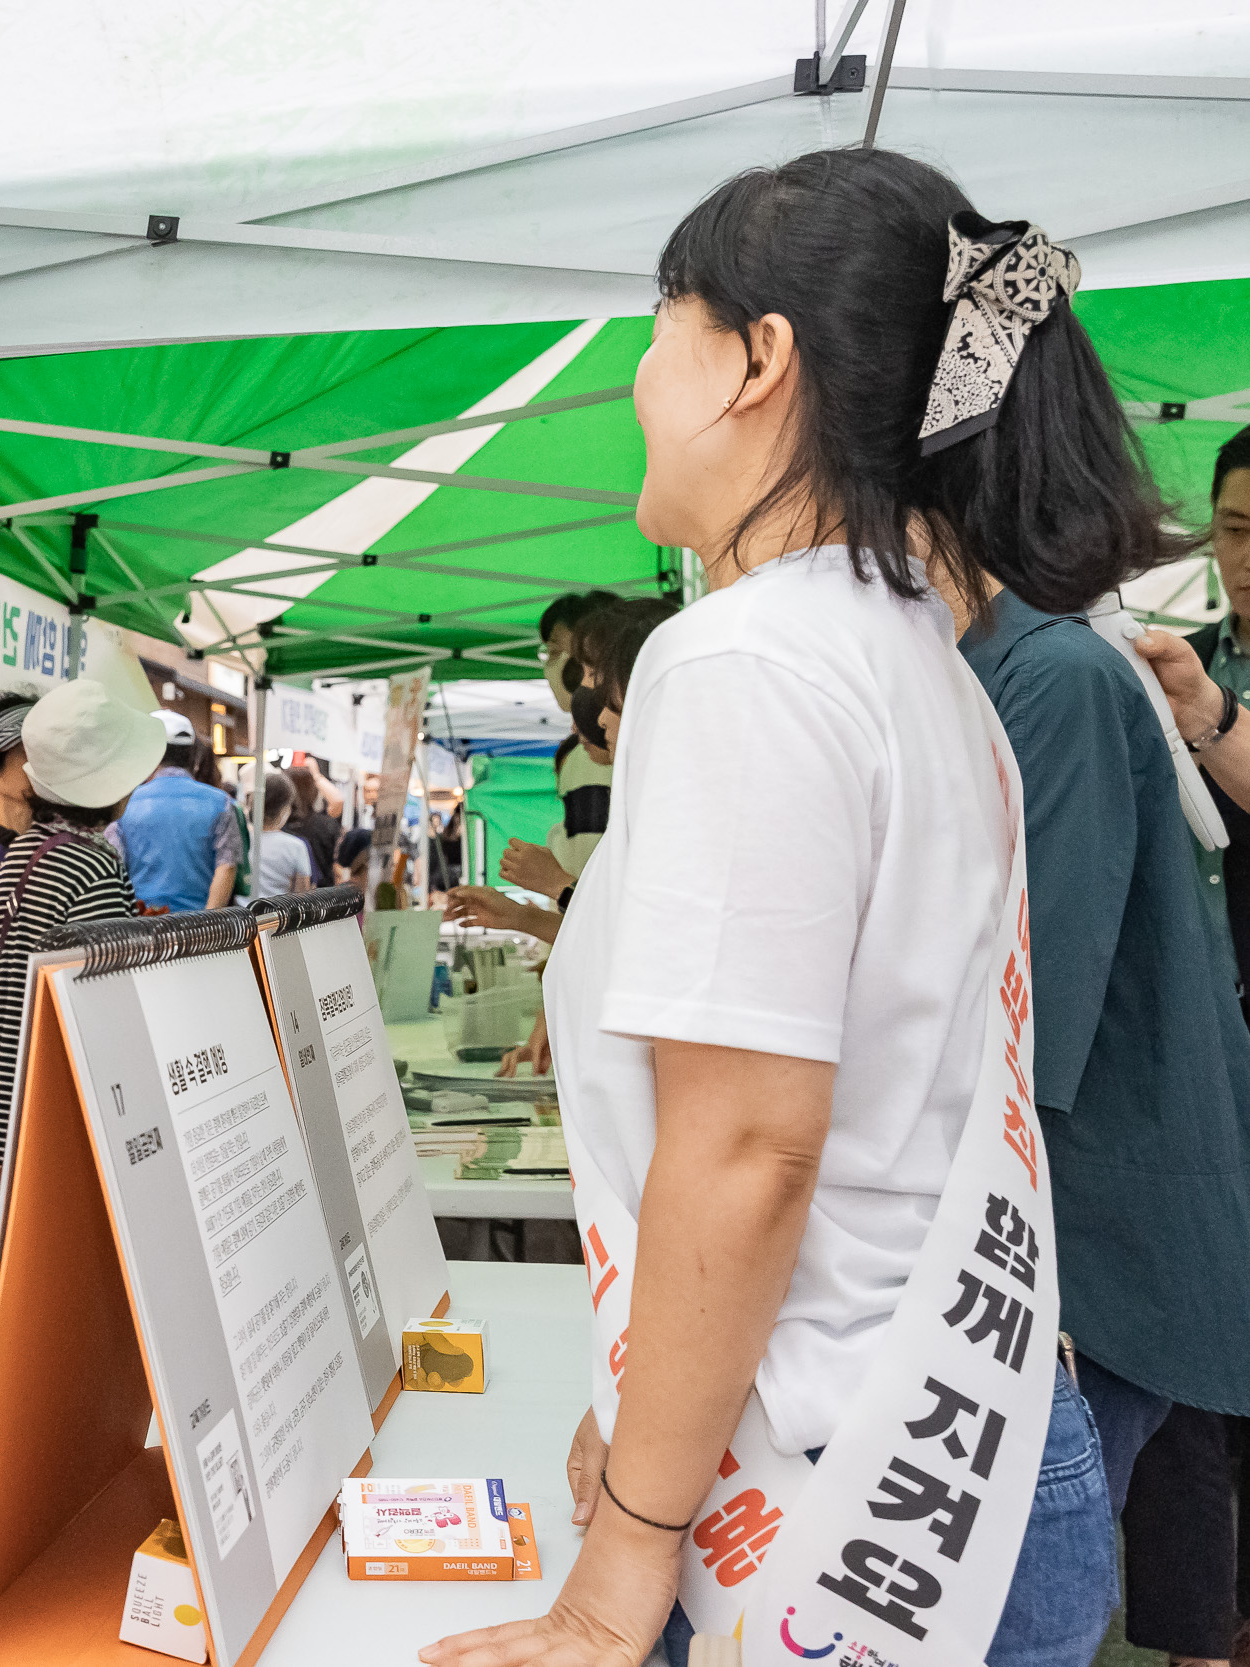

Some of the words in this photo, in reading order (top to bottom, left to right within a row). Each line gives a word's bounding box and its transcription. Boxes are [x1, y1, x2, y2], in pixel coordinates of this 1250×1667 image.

[290, 1011, 299, 1034] 14
[166, 1060, 187, 1094] 생활
[184, 1056, 197, 1086] 속
[193, 1050, 213, 1082] 결핵
[209, 1044, 228, 1075] 예방
[111, 1085, 127, 1115] 17
[942, 1191, 1040, 1374] 함께
[463, 1485, 473, 1505] DAEIL
[817, 1376, 1006, 1642] 지켜요
[465, 1507, 477, 1529] BAND
[443, 1562, 469, 1570] DAEIL
[472, 1562, 497, 1570] BAND
[130, 1573, 148, 1621] SQUEEZE
[140, 1598, 155, 1624] BALL
[150, 1595, 165, 1627] LIGHT
